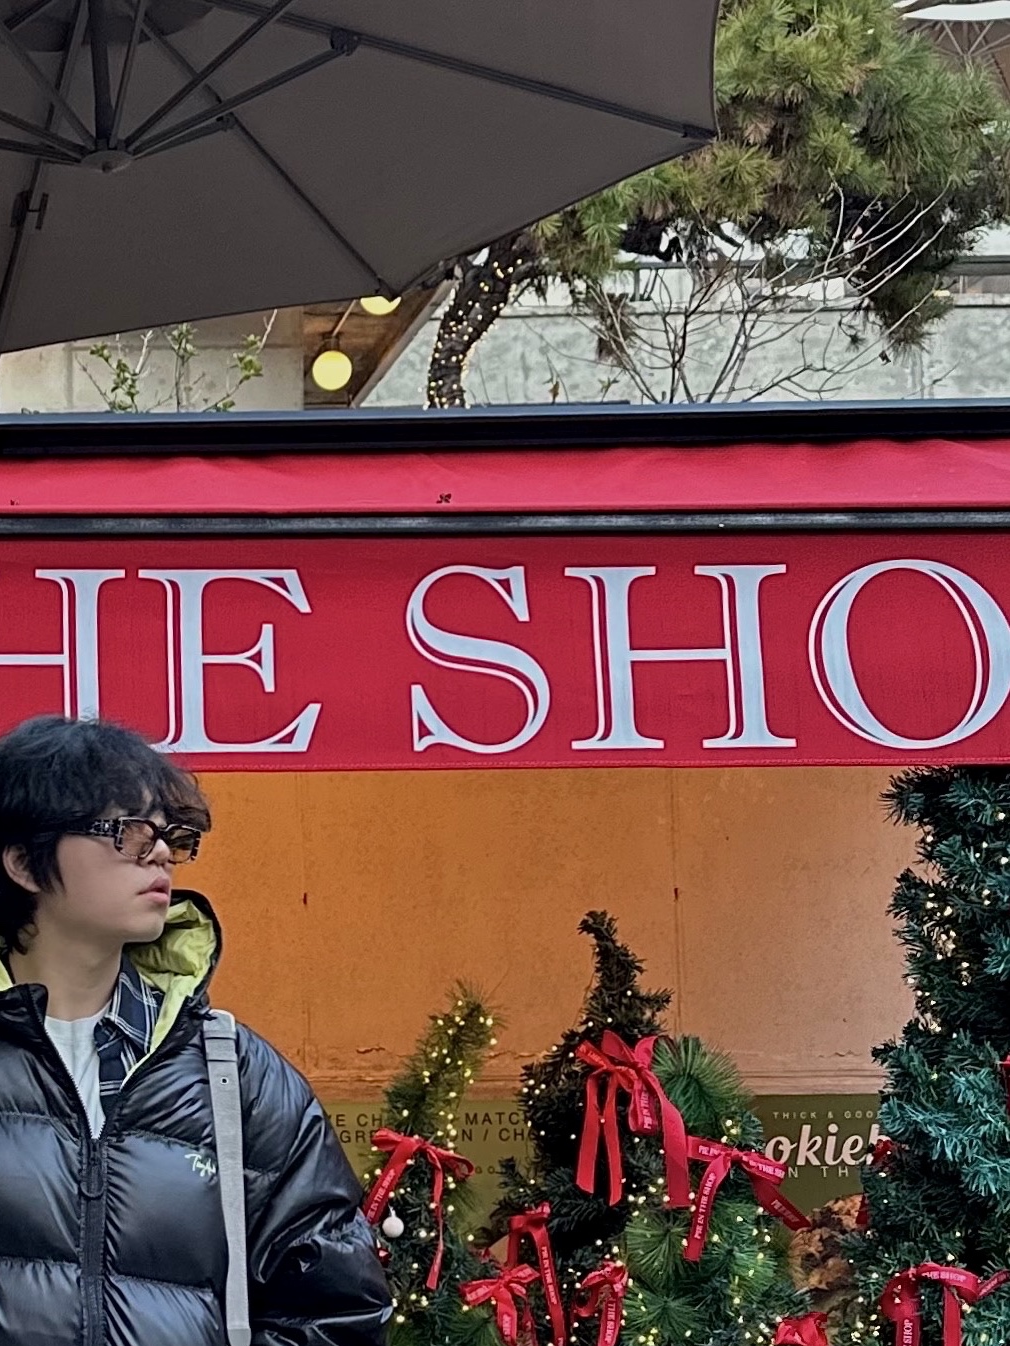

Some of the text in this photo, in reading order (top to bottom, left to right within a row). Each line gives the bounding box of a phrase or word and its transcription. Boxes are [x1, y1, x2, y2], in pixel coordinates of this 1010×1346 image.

[773, 1111, 817, 1119] THICK
[703, 1172, 716, 1195] SHOP
[939, 1272, 968, 1282] SHOP
[903, 1319, 913, 1344] SHOP
